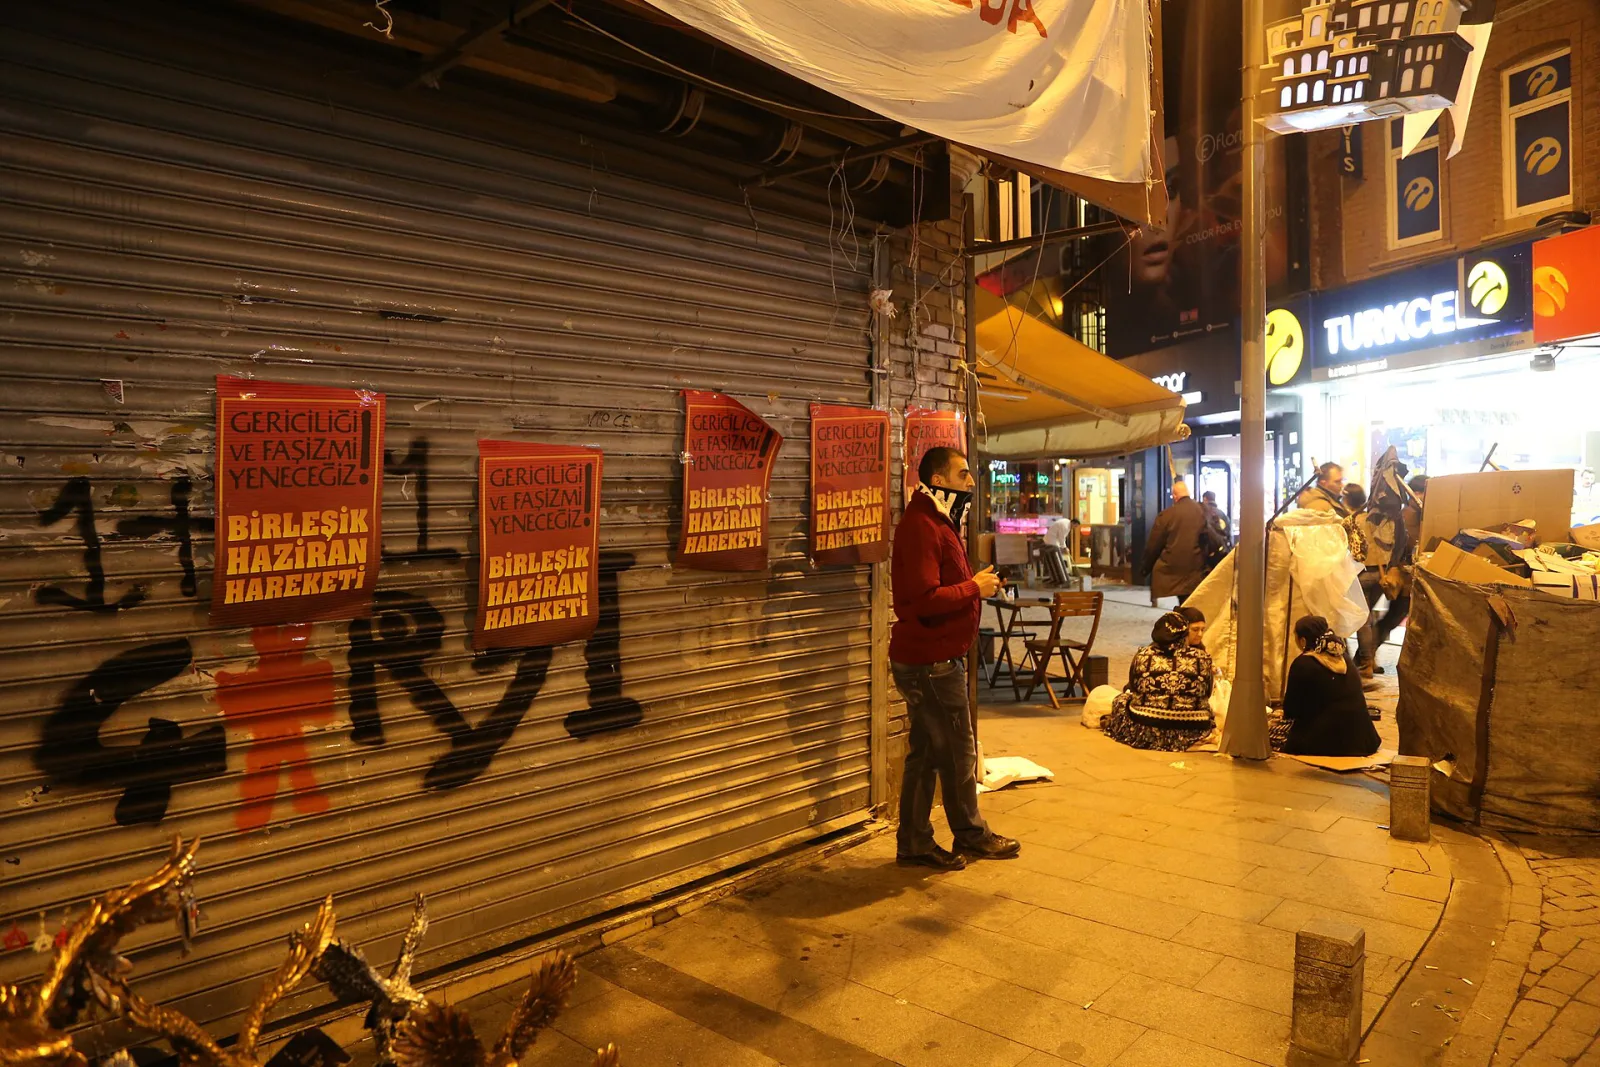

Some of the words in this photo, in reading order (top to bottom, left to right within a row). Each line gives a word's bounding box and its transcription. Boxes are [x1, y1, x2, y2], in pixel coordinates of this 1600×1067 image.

[1186, 229, 1214, 245] COLOR
[1216, 222, 1232, 237] FOR
[230, 409, 358, 433] GERİCİLİĞİ
[817, 422, 878, 441] GERİCİLİĞİ
[230, 443, 256, 462] VE
[263, 437, 357, 465] FAŞİZMİ
[692, 437, 703, 451] VE
[707, 434, 760, 454] FAŞİZMİ
[817, 446, 830, 460] VE
[832, 439, 877, 459] FAŞİZMİ
[489, 463, 582, 487] GERİCİLİĞİ
[692, 452, 756, 472] YENECEĞİZ
[817, 457, 876, 478] YENECEĞİZ
[228, 462, 357, 489] YENECEĞİZ
[490, 495, 508, 511] VE
[514, 486, 582, 511] FAŞİZMİ
[689, 484, 762, 510] BİRLEŞİK
[816, 485, 883, 511] BİRLEŞİK
[227, 506, 369, 542] BİRLEŞİK
[489, 509, 581, 536] YENECEĞİZ
[687, 506, 762, 534] HAZİRAN
[816, 506, 882, 533] HAZİRAN
[684, 529, 762, 555] HAREKETİ
[816, 524, 882, 552] HAREKETİ
[226, 538, 368, 576] HAZİRAN
[488, 544, 590, 579] BİRLEŞİK
[224, 565, 366, 605] HAREKETİ
[487, 571, 589, 607] HAZİRAN
[483, 594, 588, 631] HAREKETİ
